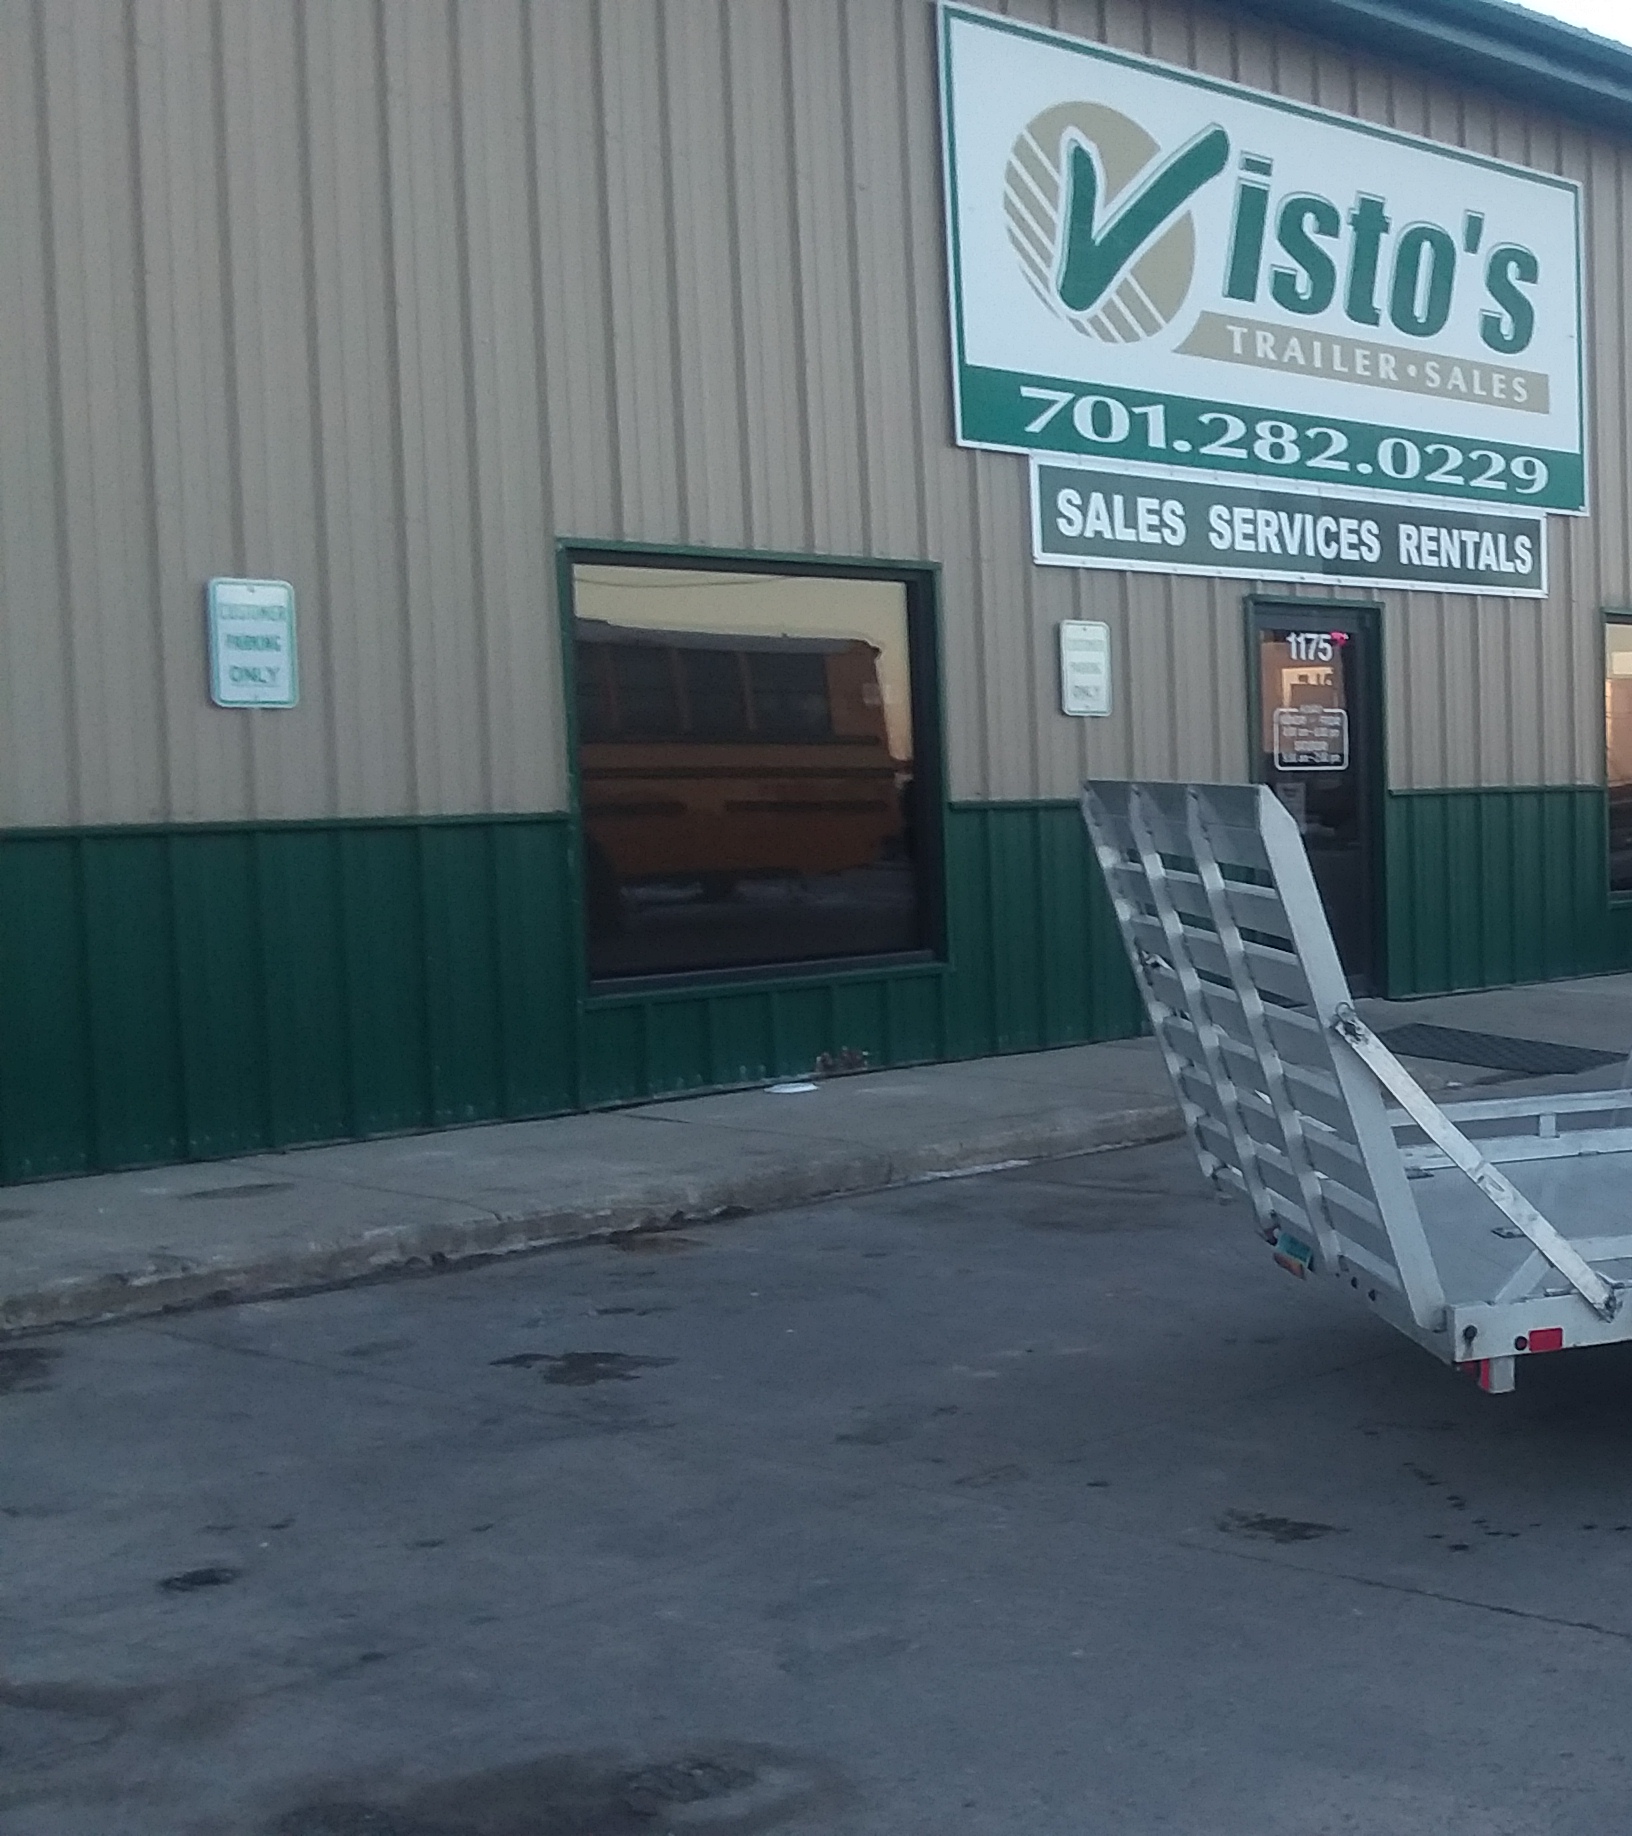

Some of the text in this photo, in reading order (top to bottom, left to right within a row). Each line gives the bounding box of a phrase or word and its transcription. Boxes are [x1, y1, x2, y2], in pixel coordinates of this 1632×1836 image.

[1058, 123, 1540, 355] Visto's
[1226, 325, 1529, 403] TRAILER SALES
[1019, 385, 1549, 495] 701.282.0229
[1056, 488, 1533, 574] SALES SERVICES RENTALS
[229, 665, 281, 684] ONLY
[1286, 632, 1334, 662] 1175
